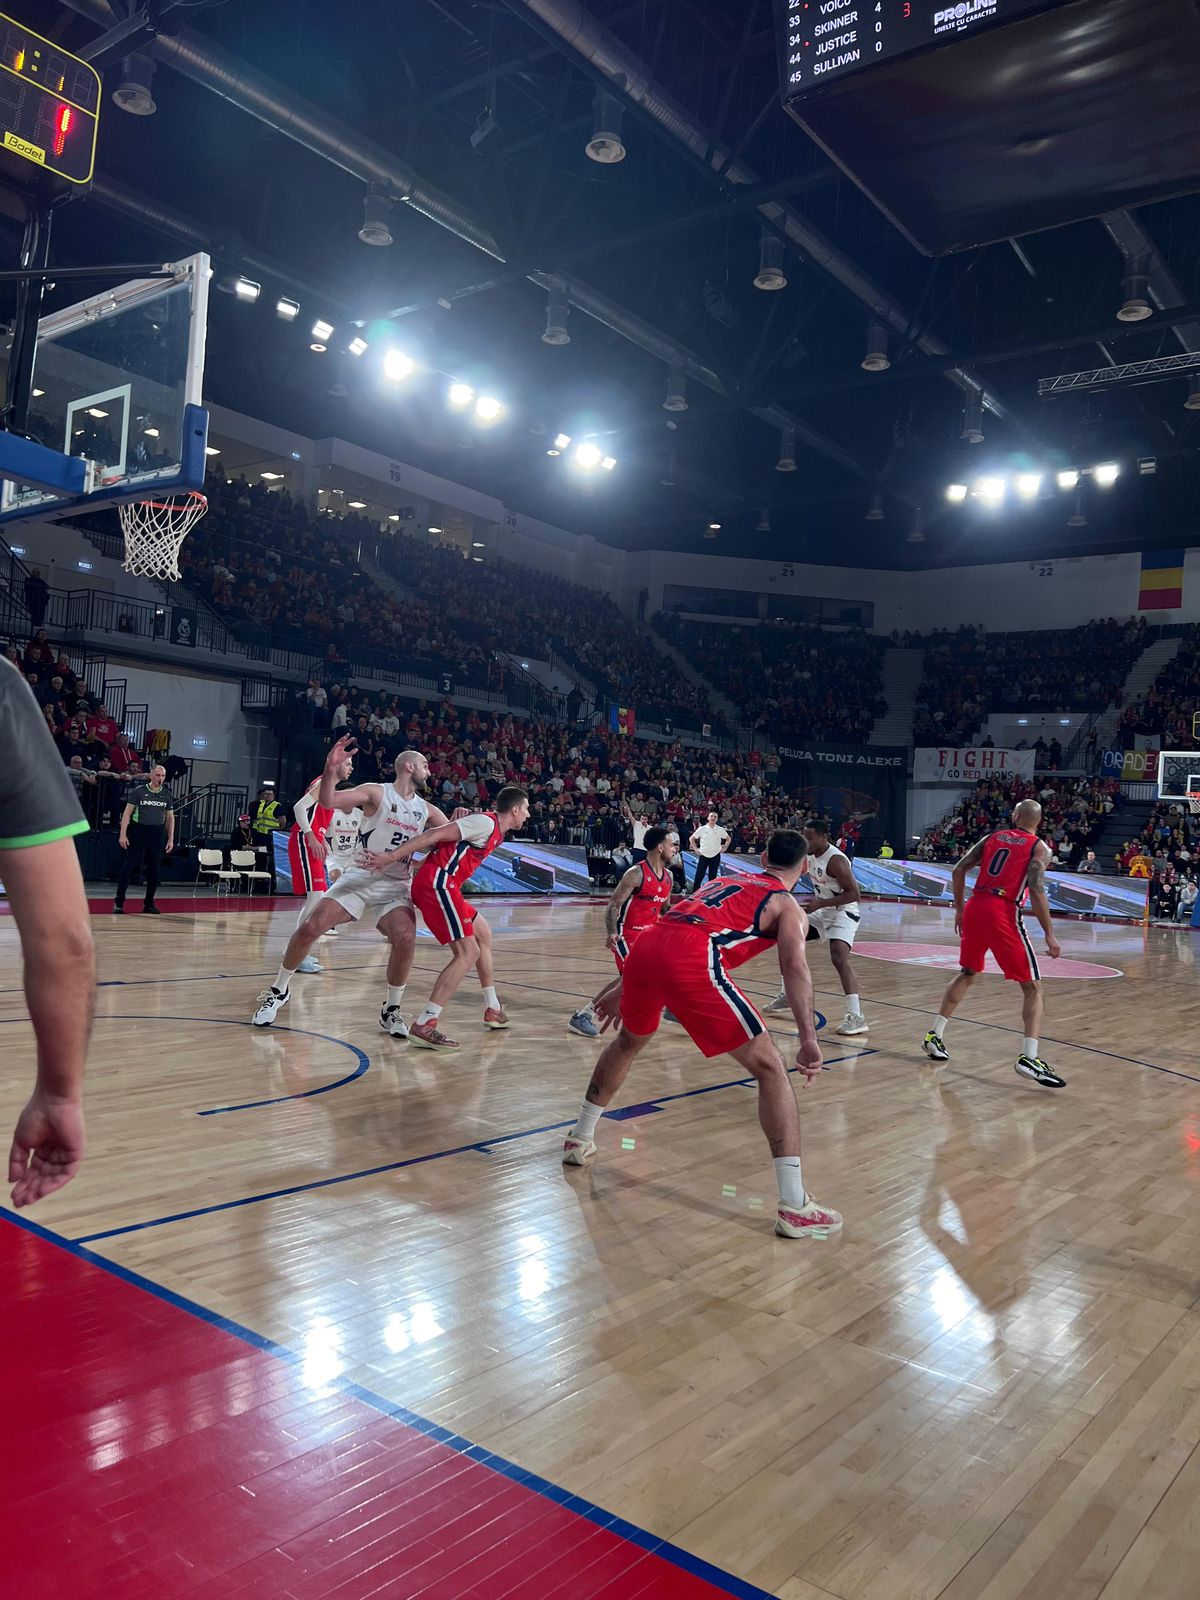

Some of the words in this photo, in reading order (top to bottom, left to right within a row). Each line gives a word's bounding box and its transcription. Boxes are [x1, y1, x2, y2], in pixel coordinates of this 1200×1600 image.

[789, 0, 800, 9] 22
[903, 2, 911, 18] 3
[789, 15, 800, 27] 33
[789, 33, 800, 46] 34
[814, 11, 858, 36] SKINNER
[874, 2, 882, 12] 4
[934, 21, 956, 34] UNELTE
[956, 18, 965, 26] CU
[965, 7, 997, 23] CARACTER
[789, 52, 801, 64] 44
[815, 30, 858, 56] JUSTICE
[874, 21, 882, 33] 0
[789, 70, 802, 83] 45
[813, 48, 860, 75] SULLIVAN
[875, 41, 882, 52] 0
[8, 135, 44, 162] Bodet
[389, 470, 400, 481] 19
[782, 568, 794, 577] 21
[1039, 567, 1054, 577] 22
[443, 679, 451, 691] 3
[816, 752, 854, 764] TONI
[855, 756, 902, 766] ALEXE
[938, 750, 1008, 768] FIGHT
[947, 769, 960, 778] GO
[962, 770, 981, 779] RED
[985, 770, 1014, 780] LIONS
[339, 835, 351, 844] 34
[987, 847, 1011, 877] 0
